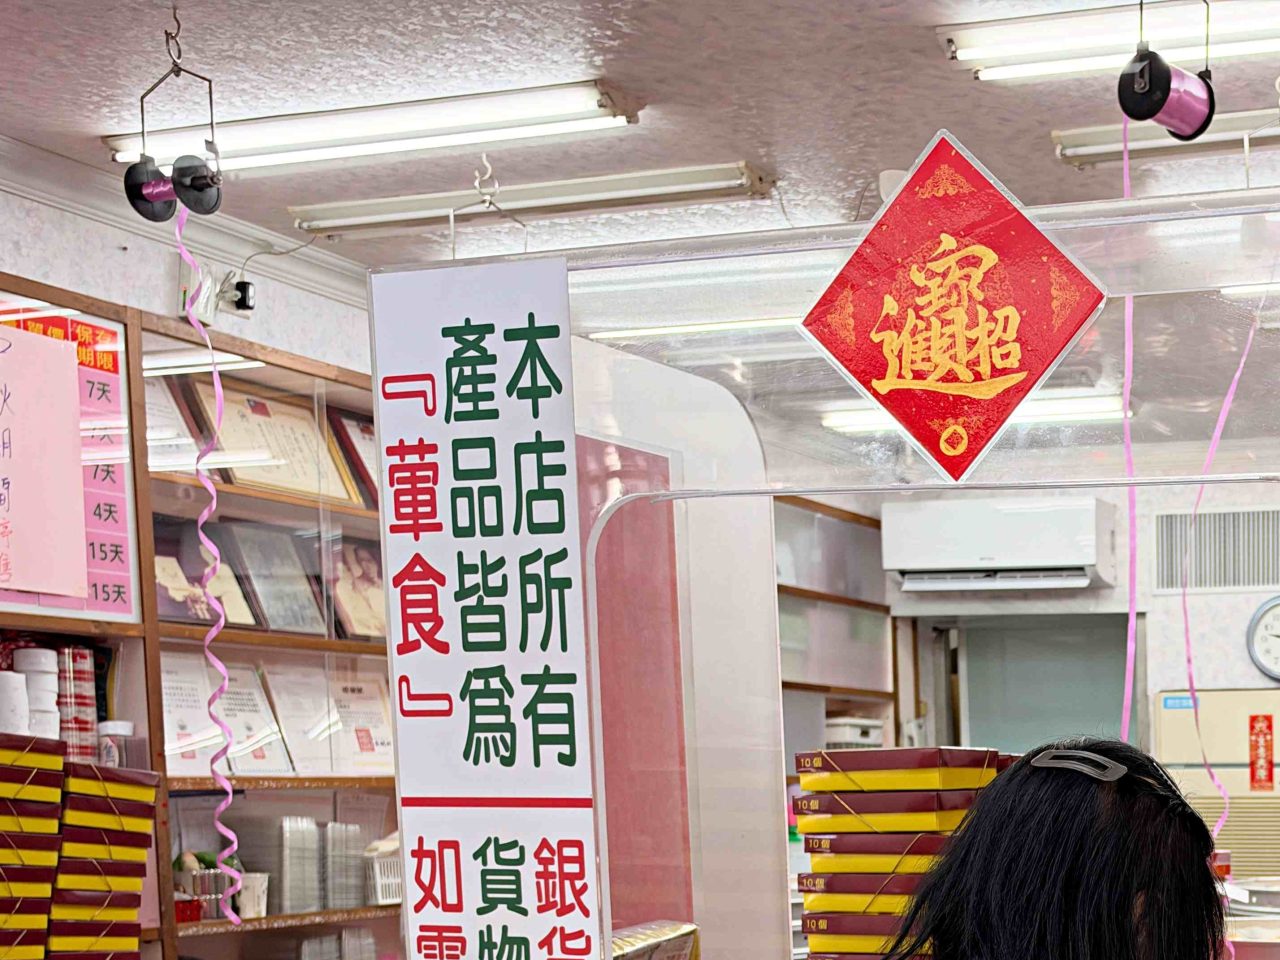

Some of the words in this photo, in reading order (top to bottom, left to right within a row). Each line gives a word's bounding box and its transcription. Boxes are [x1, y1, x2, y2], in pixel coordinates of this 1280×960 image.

[86, 380, 112, 403] 7天
[93, 503, 119, 524] 4天
[503, 312, 578, 768] 本店所有
[89, 542, 125, 564] 15天
[91, 583, 127, 604] 15天
